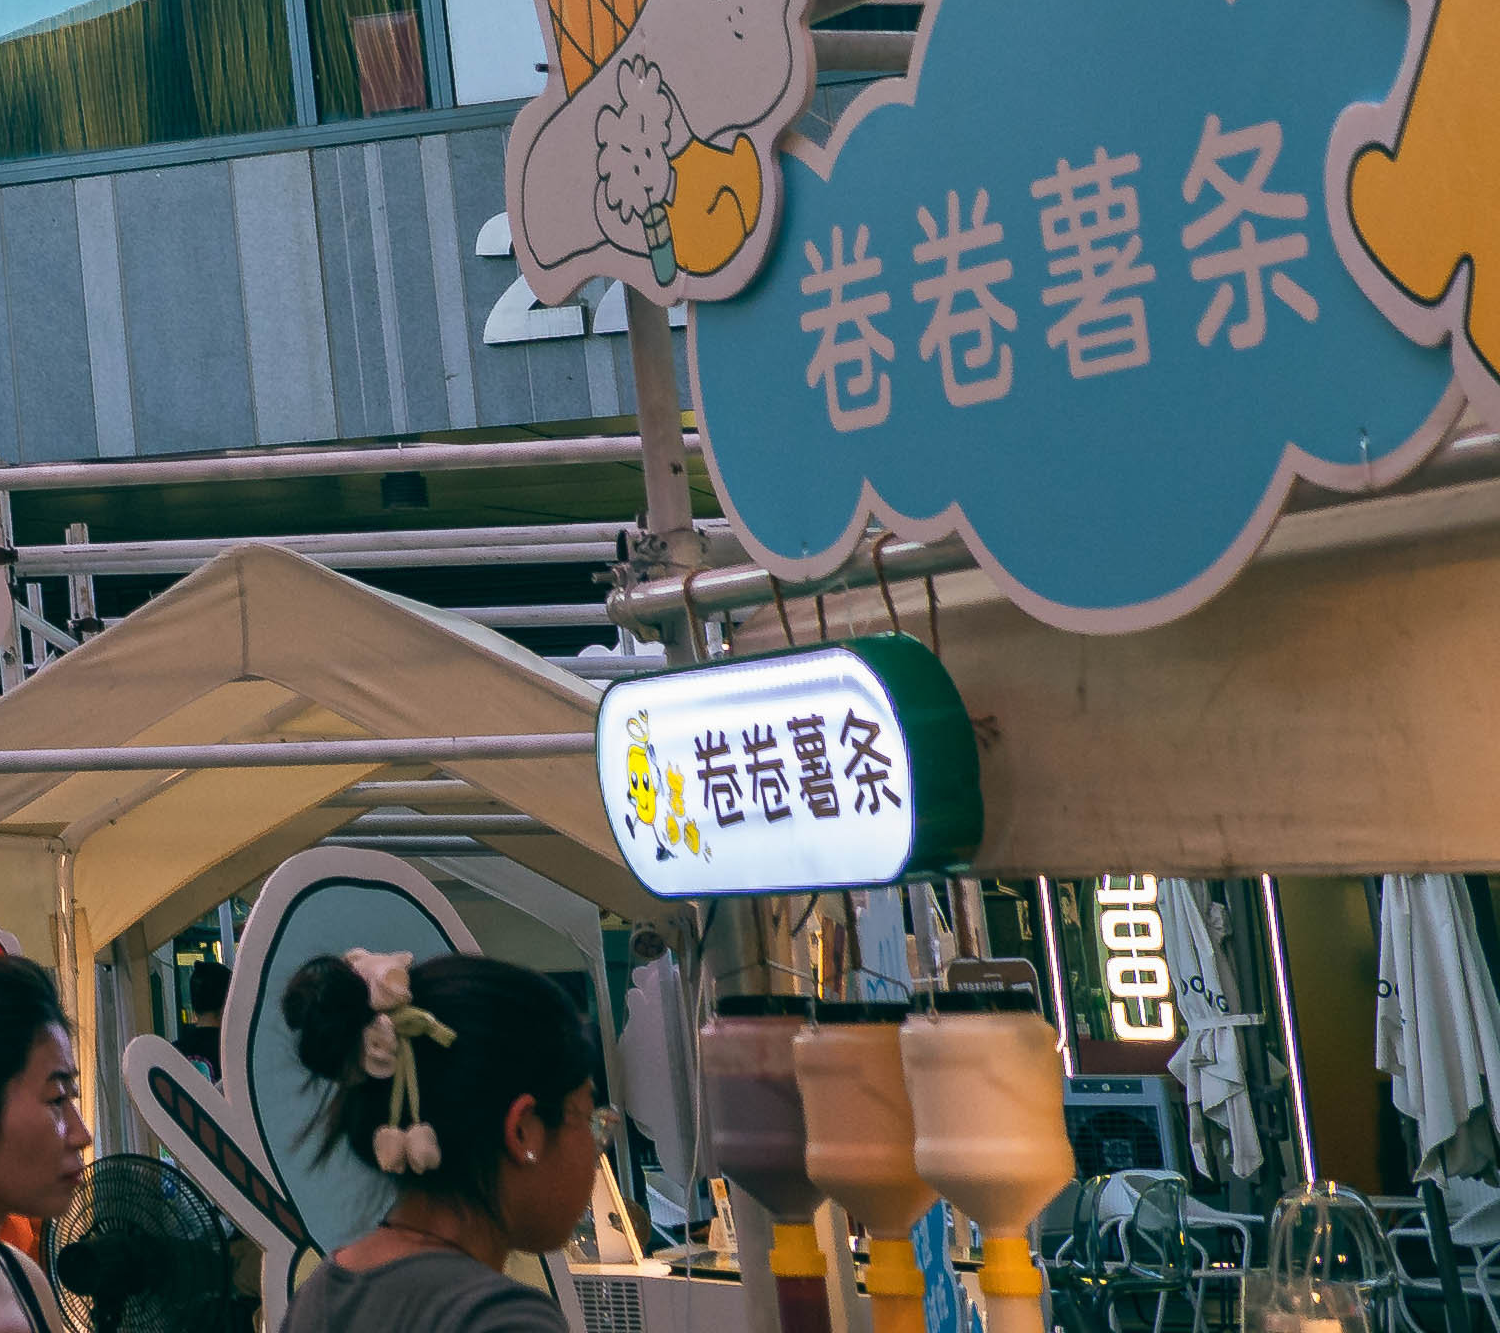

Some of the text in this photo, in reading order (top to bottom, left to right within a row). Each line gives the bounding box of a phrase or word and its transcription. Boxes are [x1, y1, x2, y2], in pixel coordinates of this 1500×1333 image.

[801, 114, 1318, 434] 卷卷薯条
[695, 708, 901, 828] 卷卷薯条
